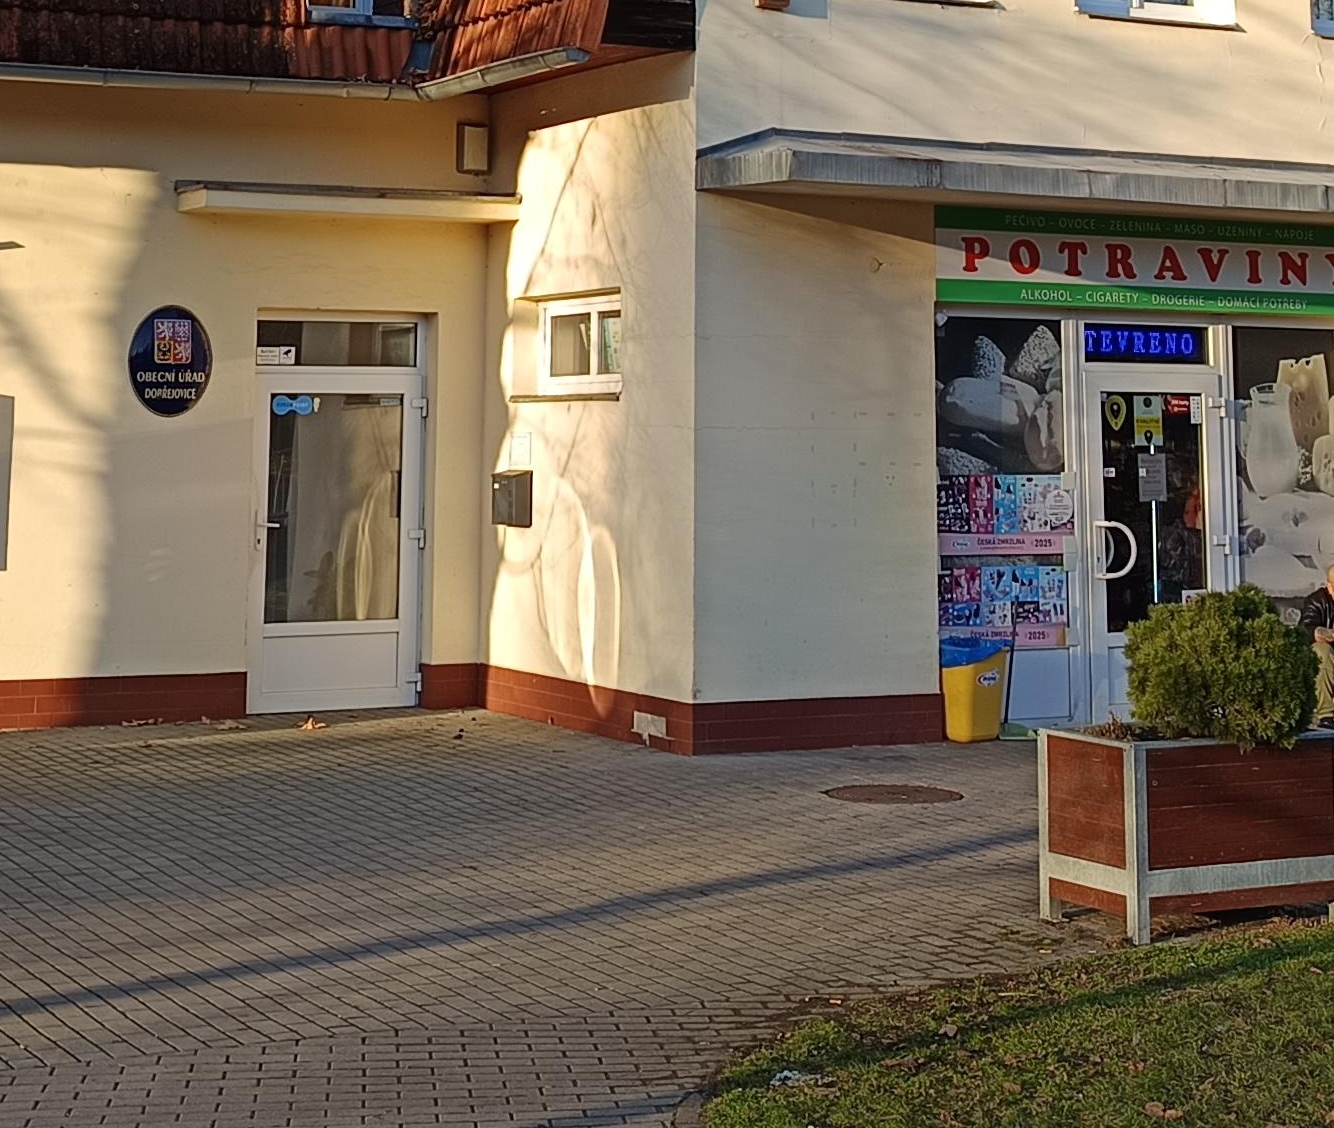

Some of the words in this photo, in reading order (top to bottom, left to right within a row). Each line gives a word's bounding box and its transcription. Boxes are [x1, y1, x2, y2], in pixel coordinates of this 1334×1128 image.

[1058, 217, 1096, 230] OVOCE
[1109, 220, 1162, 233] ZELENINA
[1174, 223, 1206, 235] MASO
[1217, 225, 1263, 238] UZENINY
[1020, 288, 1073, 302] ALKOHOL
[1085, 291, 1139, 304] CIGARETY
[1151, 293, 1205, 306] DROGERIE
[136, 368, 175, 382] OBECNÍ
[178, 368, 205, 382] ÚŘAD
[1034, 539, 1053, 548] 2025
[1028, 631, 1046, 640] 2025
